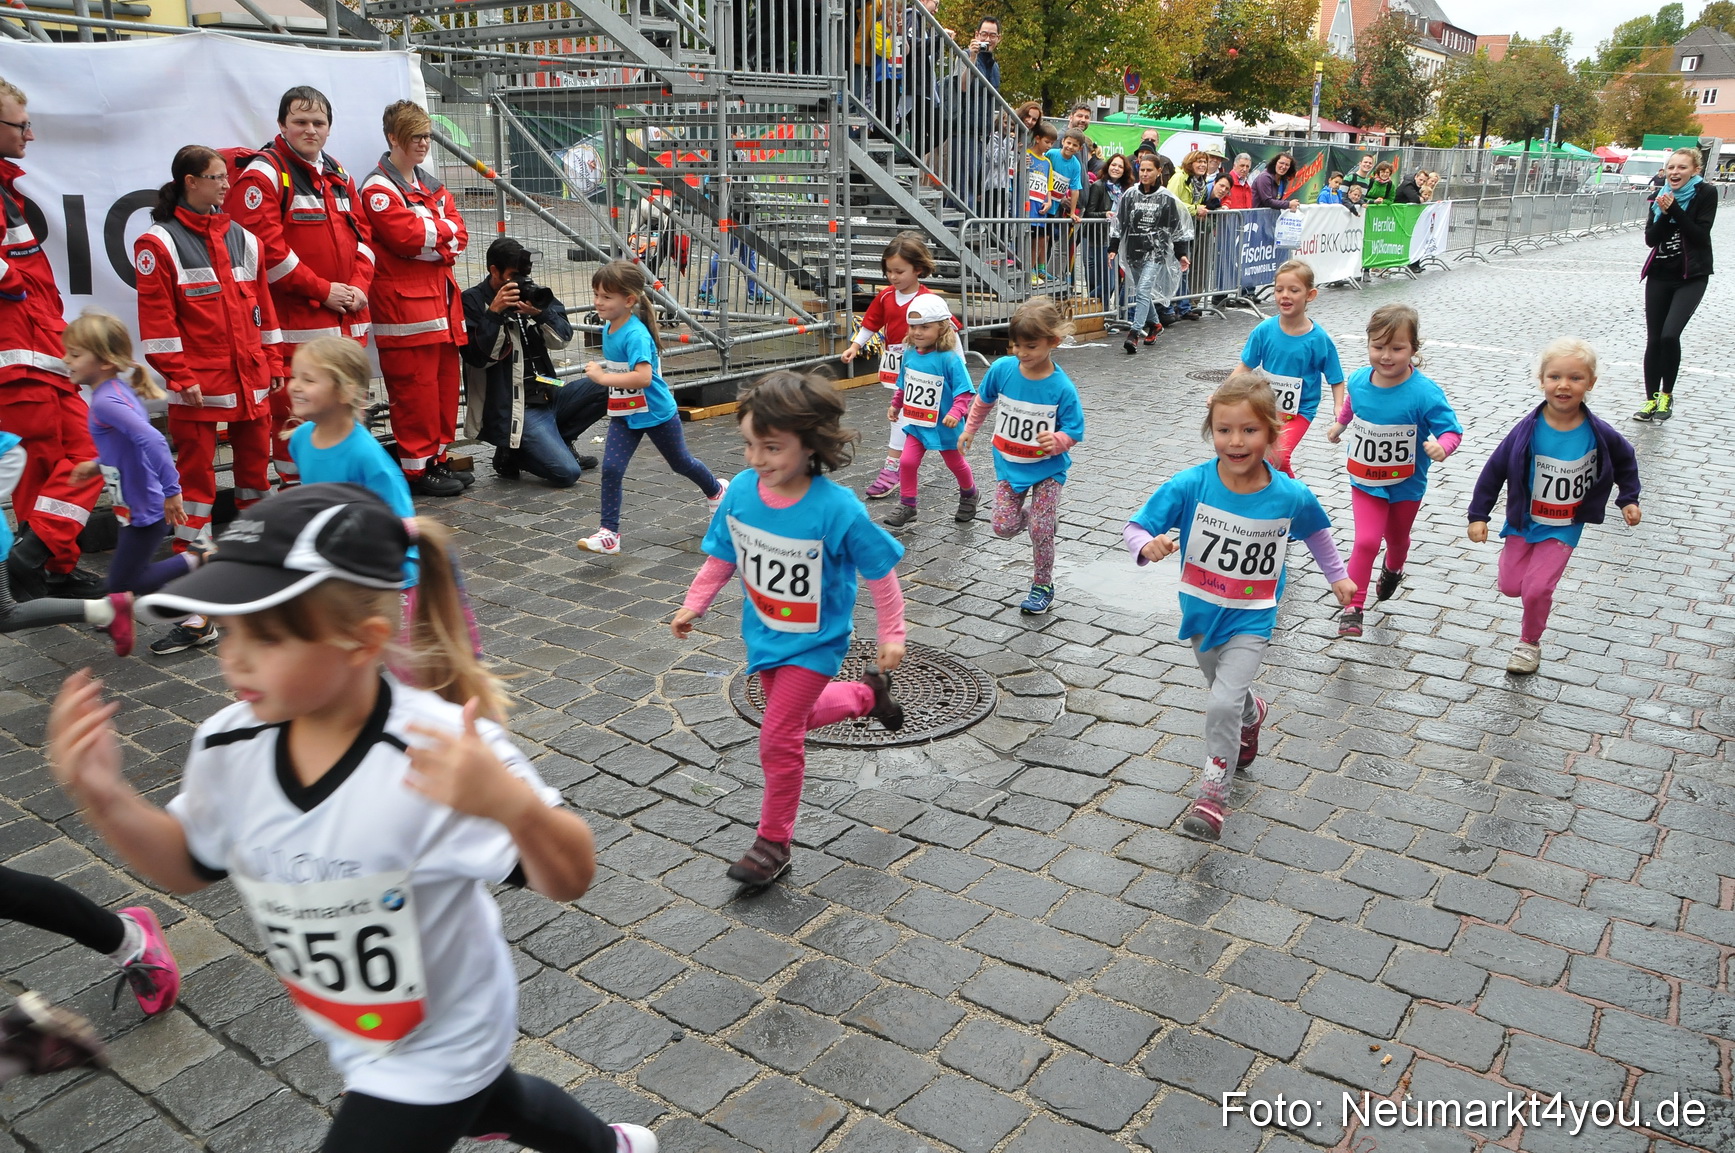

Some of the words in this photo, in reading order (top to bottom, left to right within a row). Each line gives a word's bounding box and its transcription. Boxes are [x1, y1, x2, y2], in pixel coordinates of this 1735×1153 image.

[1053, 179, 1069, 193] 066
[1372, 216, 1396, 232] Herzlich
[1320, 233, 1340, 253] BKK
[1241, 241, 1277, 264] Fischer
[1244, 262, 1277, 276] AUTOMOBILE
[905, 382, 936, 407] 023
[1013, 407, 1045, 417] Neumarkt
[1368, 430, 1403, 438] Neumarkt
[1004, 443, 1034, 456] Natalie
[1354, 434, 1409, 463] 7035
[1365, 468, 1387, 480] Anja
[1536, 461, 1559, 473] PARTL
[1541, 467, 1594, 501] 7085
[1537, 504, 1568, 516] Janna
[1196, 513, 1230, 532] PARTL
[1232, 525, 1276, 538] Neumarkt
[754, 538, 803, 558] Neumarkt
[1199, 529, 1277, 575] 7588
[1197, 569, 1226, 592] Julia
